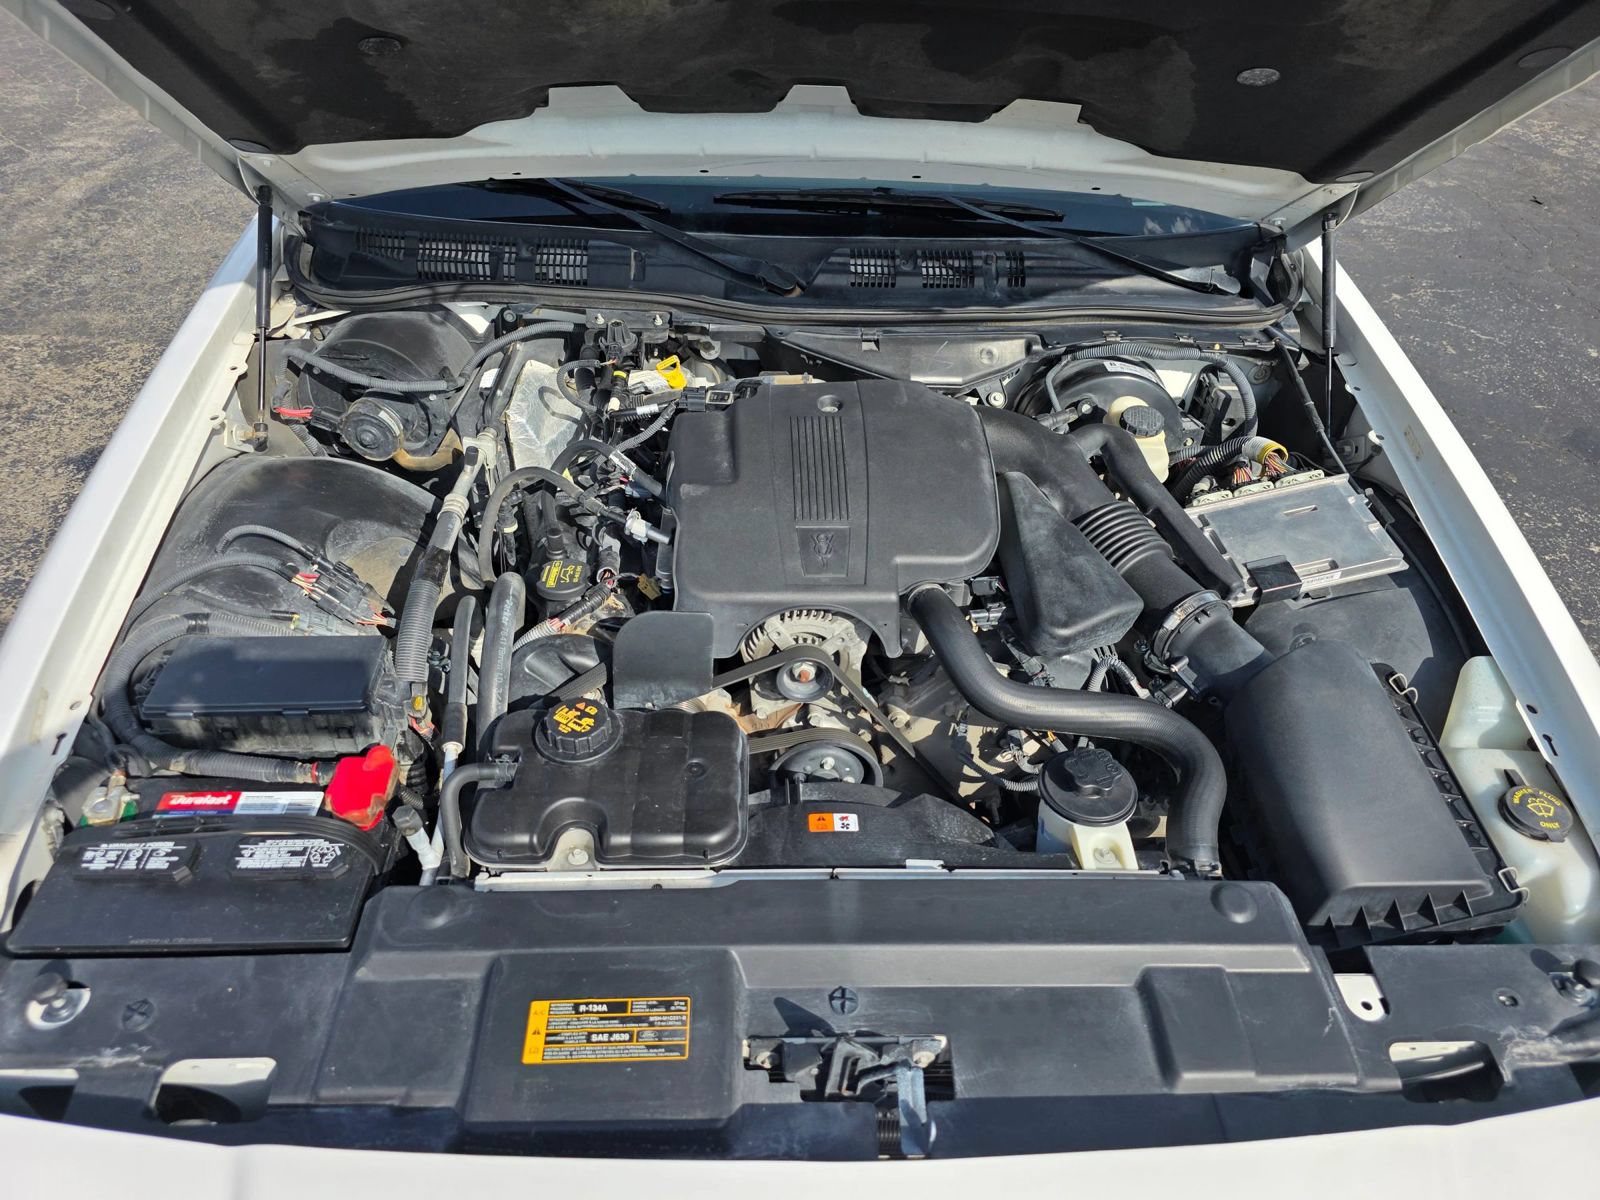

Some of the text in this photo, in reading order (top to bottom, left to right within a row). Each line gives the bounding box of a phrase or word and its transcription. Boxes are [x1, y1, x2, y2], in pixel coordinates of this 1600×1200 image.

[168, 794, 232, 806] Duralast
[1539, 790, 1561, 806] FLUID
[1540, 821, 1560, 829] ONLY
[579, 1004, 608, 1013] R-134A
[591, 1033, 609, 1043] SAE
[610, 1033, 630, 1042] J639
